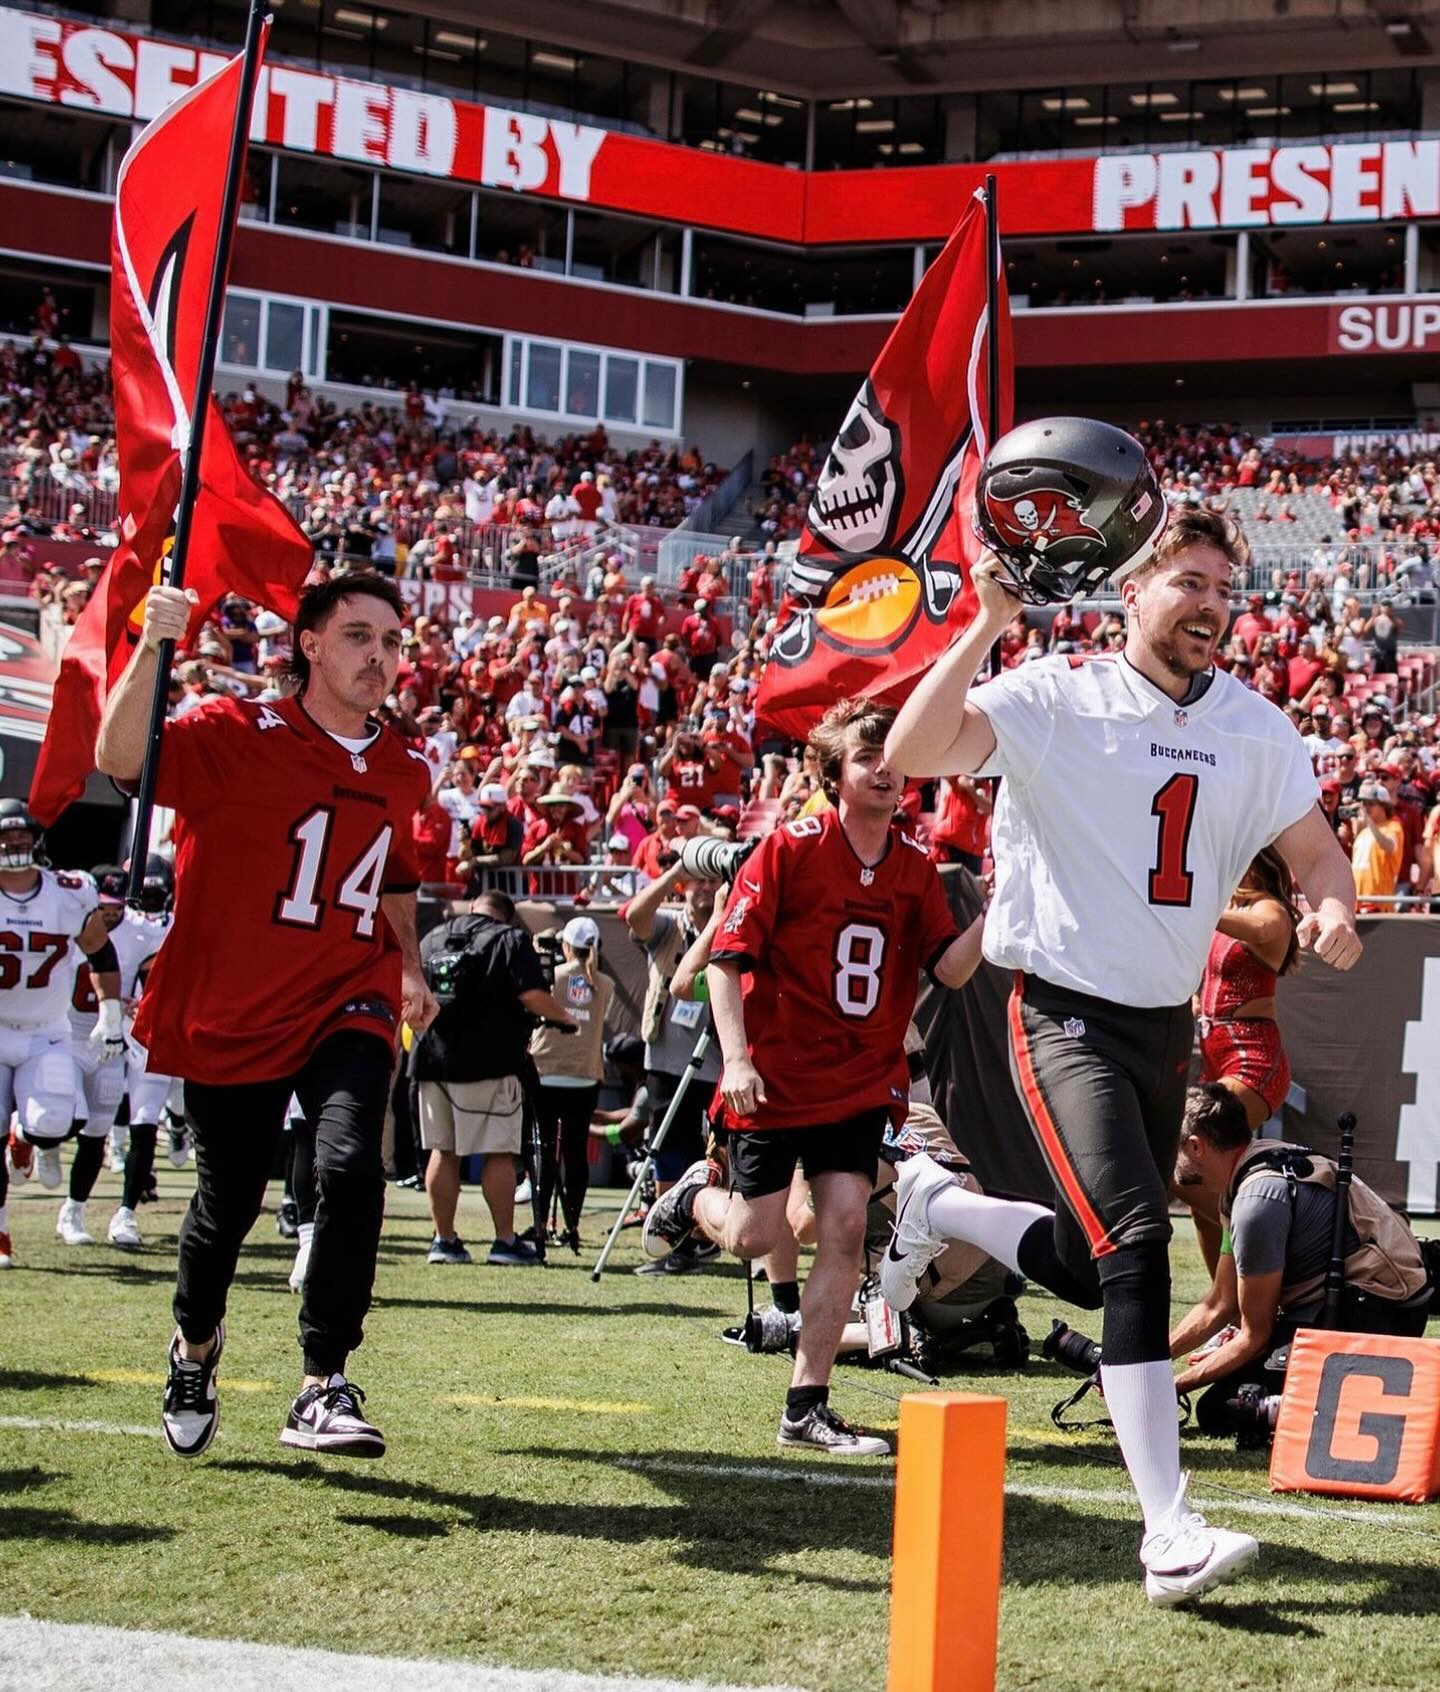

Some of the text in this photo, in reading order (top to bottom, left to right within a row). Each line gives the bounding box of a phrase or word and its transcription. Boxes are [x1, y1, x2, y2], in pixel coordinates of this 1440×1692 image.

[482, 105, 606, 201] BY
[1093, 139, 1440, 231] PRESEN
[1337, 304, 1440, 350] SUP
[680, 764, 704, 787] 21
[1150, 742, 1216, 767] BUCCANEERS
[275, 806, 394, 940] 14
[1149, 773, 1199, 906] 1
[833, 921, 887, 1019] 8
[1305, 1352, 1414, 1485] G
